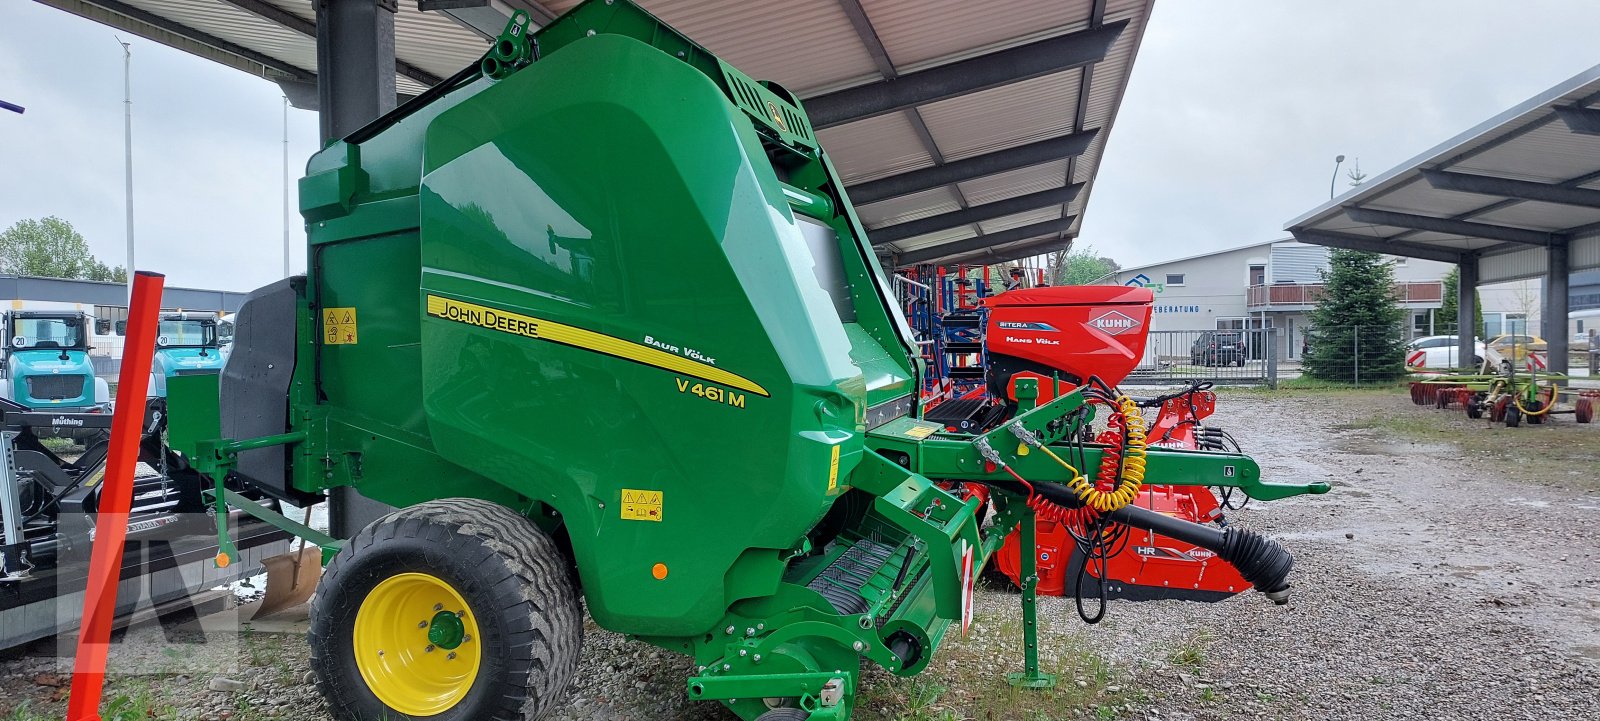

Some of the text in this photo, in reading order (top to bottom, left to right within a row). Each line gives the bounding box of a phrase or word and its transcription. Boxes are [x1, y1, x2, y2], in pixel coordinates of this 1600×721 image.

[441, 302, 539, 336] JOHN DEERE
[1097, 319, 1132, 328] KUHN
[16, 337, 25, 346] 20
[160, 336, 168, 345] 20
[675, 377, 746, 409] V 461 M
[1137, 546, 1156, 556] HR
[1189, 550, 1212, 558] KUHN
